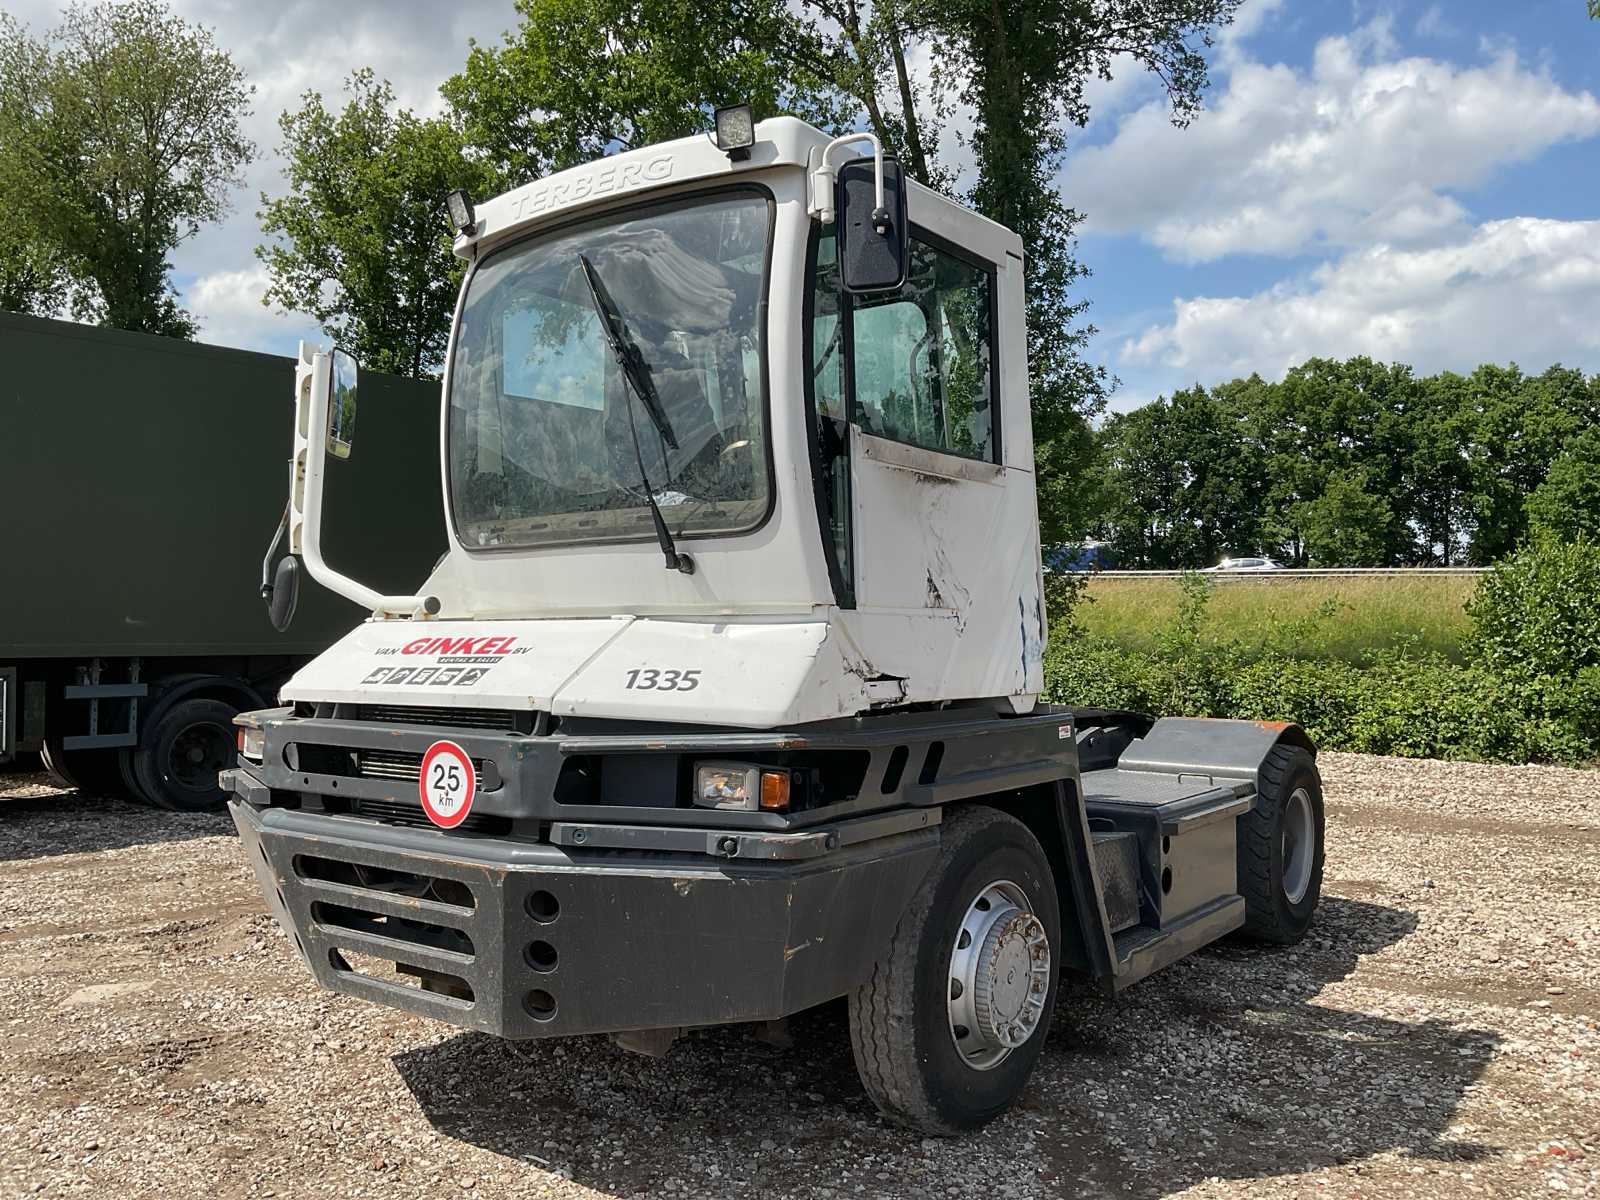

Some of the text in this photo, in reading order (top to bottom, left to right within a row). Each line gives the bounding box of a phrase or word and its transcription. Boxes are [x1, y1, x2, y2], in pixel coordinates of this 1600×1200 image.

[511, 154, 674, 219] TERBERG
[375, 637, 533, 656] VAN GINKEL BV
[624, 669, 702, 692] 1335
[433, 764, 460, 791] 25
[439, 793, 453, 807] km
